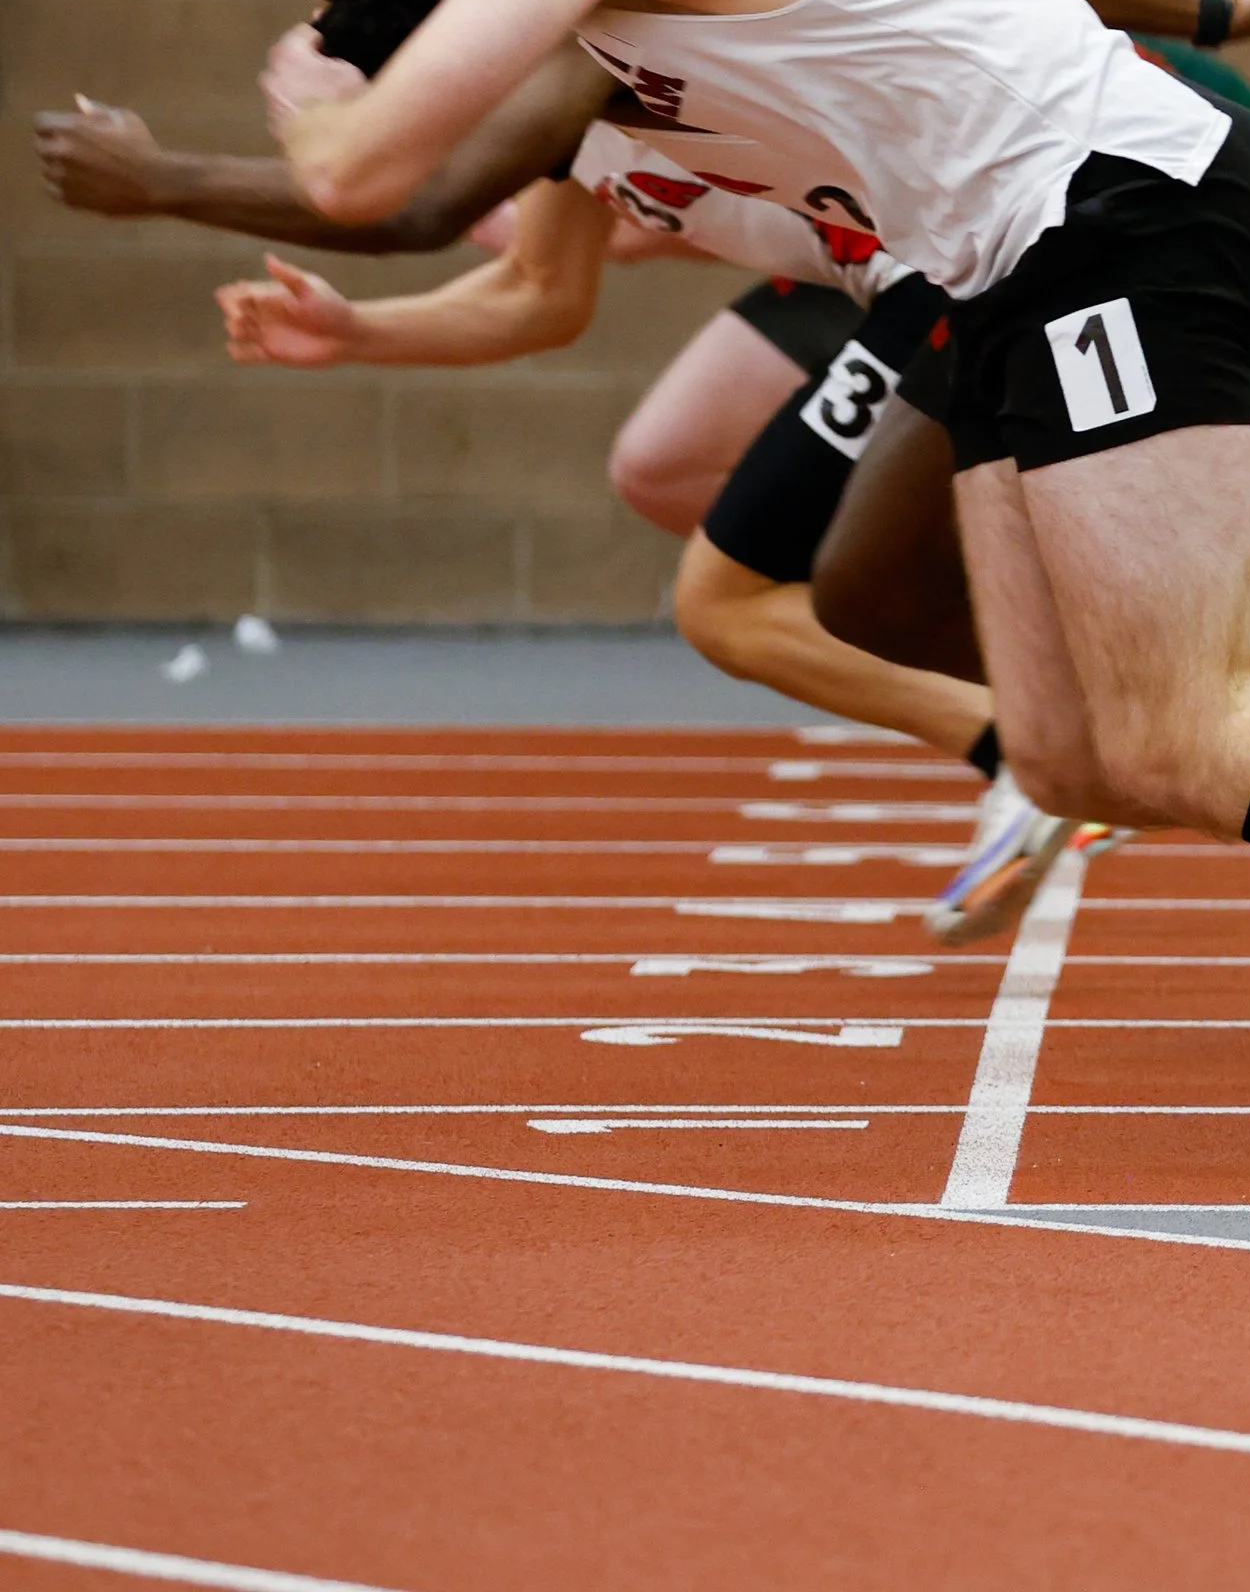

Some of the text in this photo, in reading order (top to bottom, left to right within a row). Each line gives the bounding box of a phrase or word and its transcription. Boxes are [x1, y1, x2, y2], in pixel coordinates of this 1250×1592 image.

[1075, 312, 1129, 415] 1
[820, 359, 886, 439] 3
[579, 1023, 905, 1048] 2
[526, 1118, 871, 1135] 1
